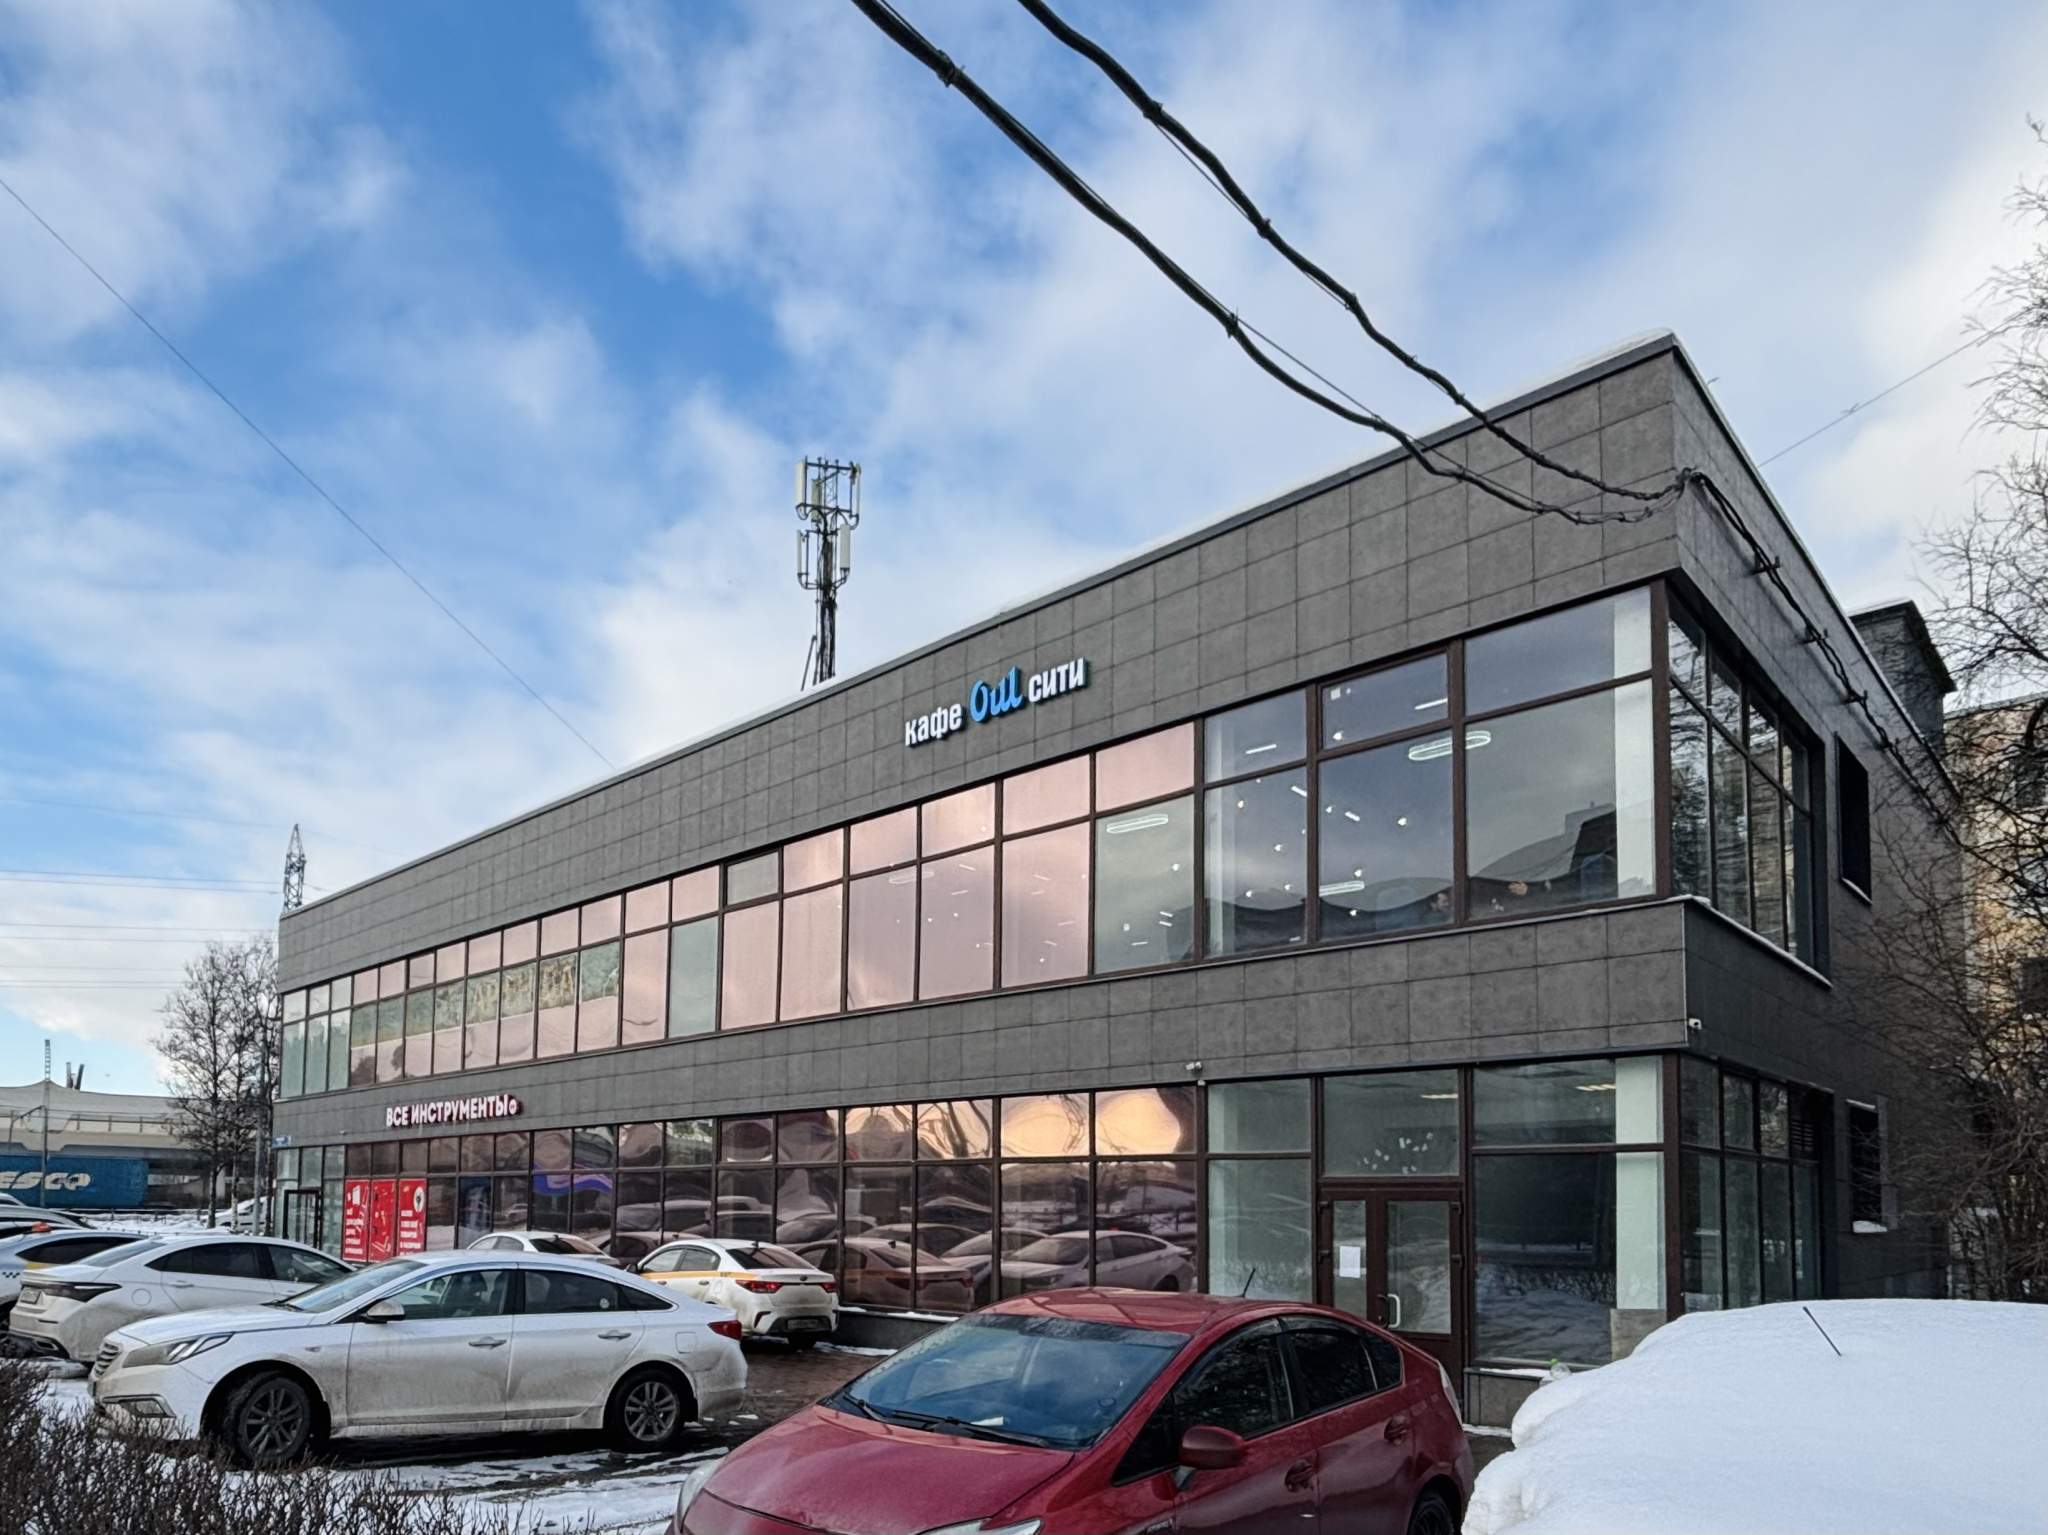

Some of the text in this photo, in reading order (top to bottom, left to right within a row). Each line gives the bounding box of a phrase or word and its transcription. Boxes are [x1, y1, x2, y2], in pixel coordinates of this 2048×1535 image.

[905, 703, 963, 746] кафе
[1028, 657, 1087, 702] сити
[386, 1106, 409, 1127] ВСЕ
[410, 1094, 508, 1125] ИНСТРУМЕНТЫ
